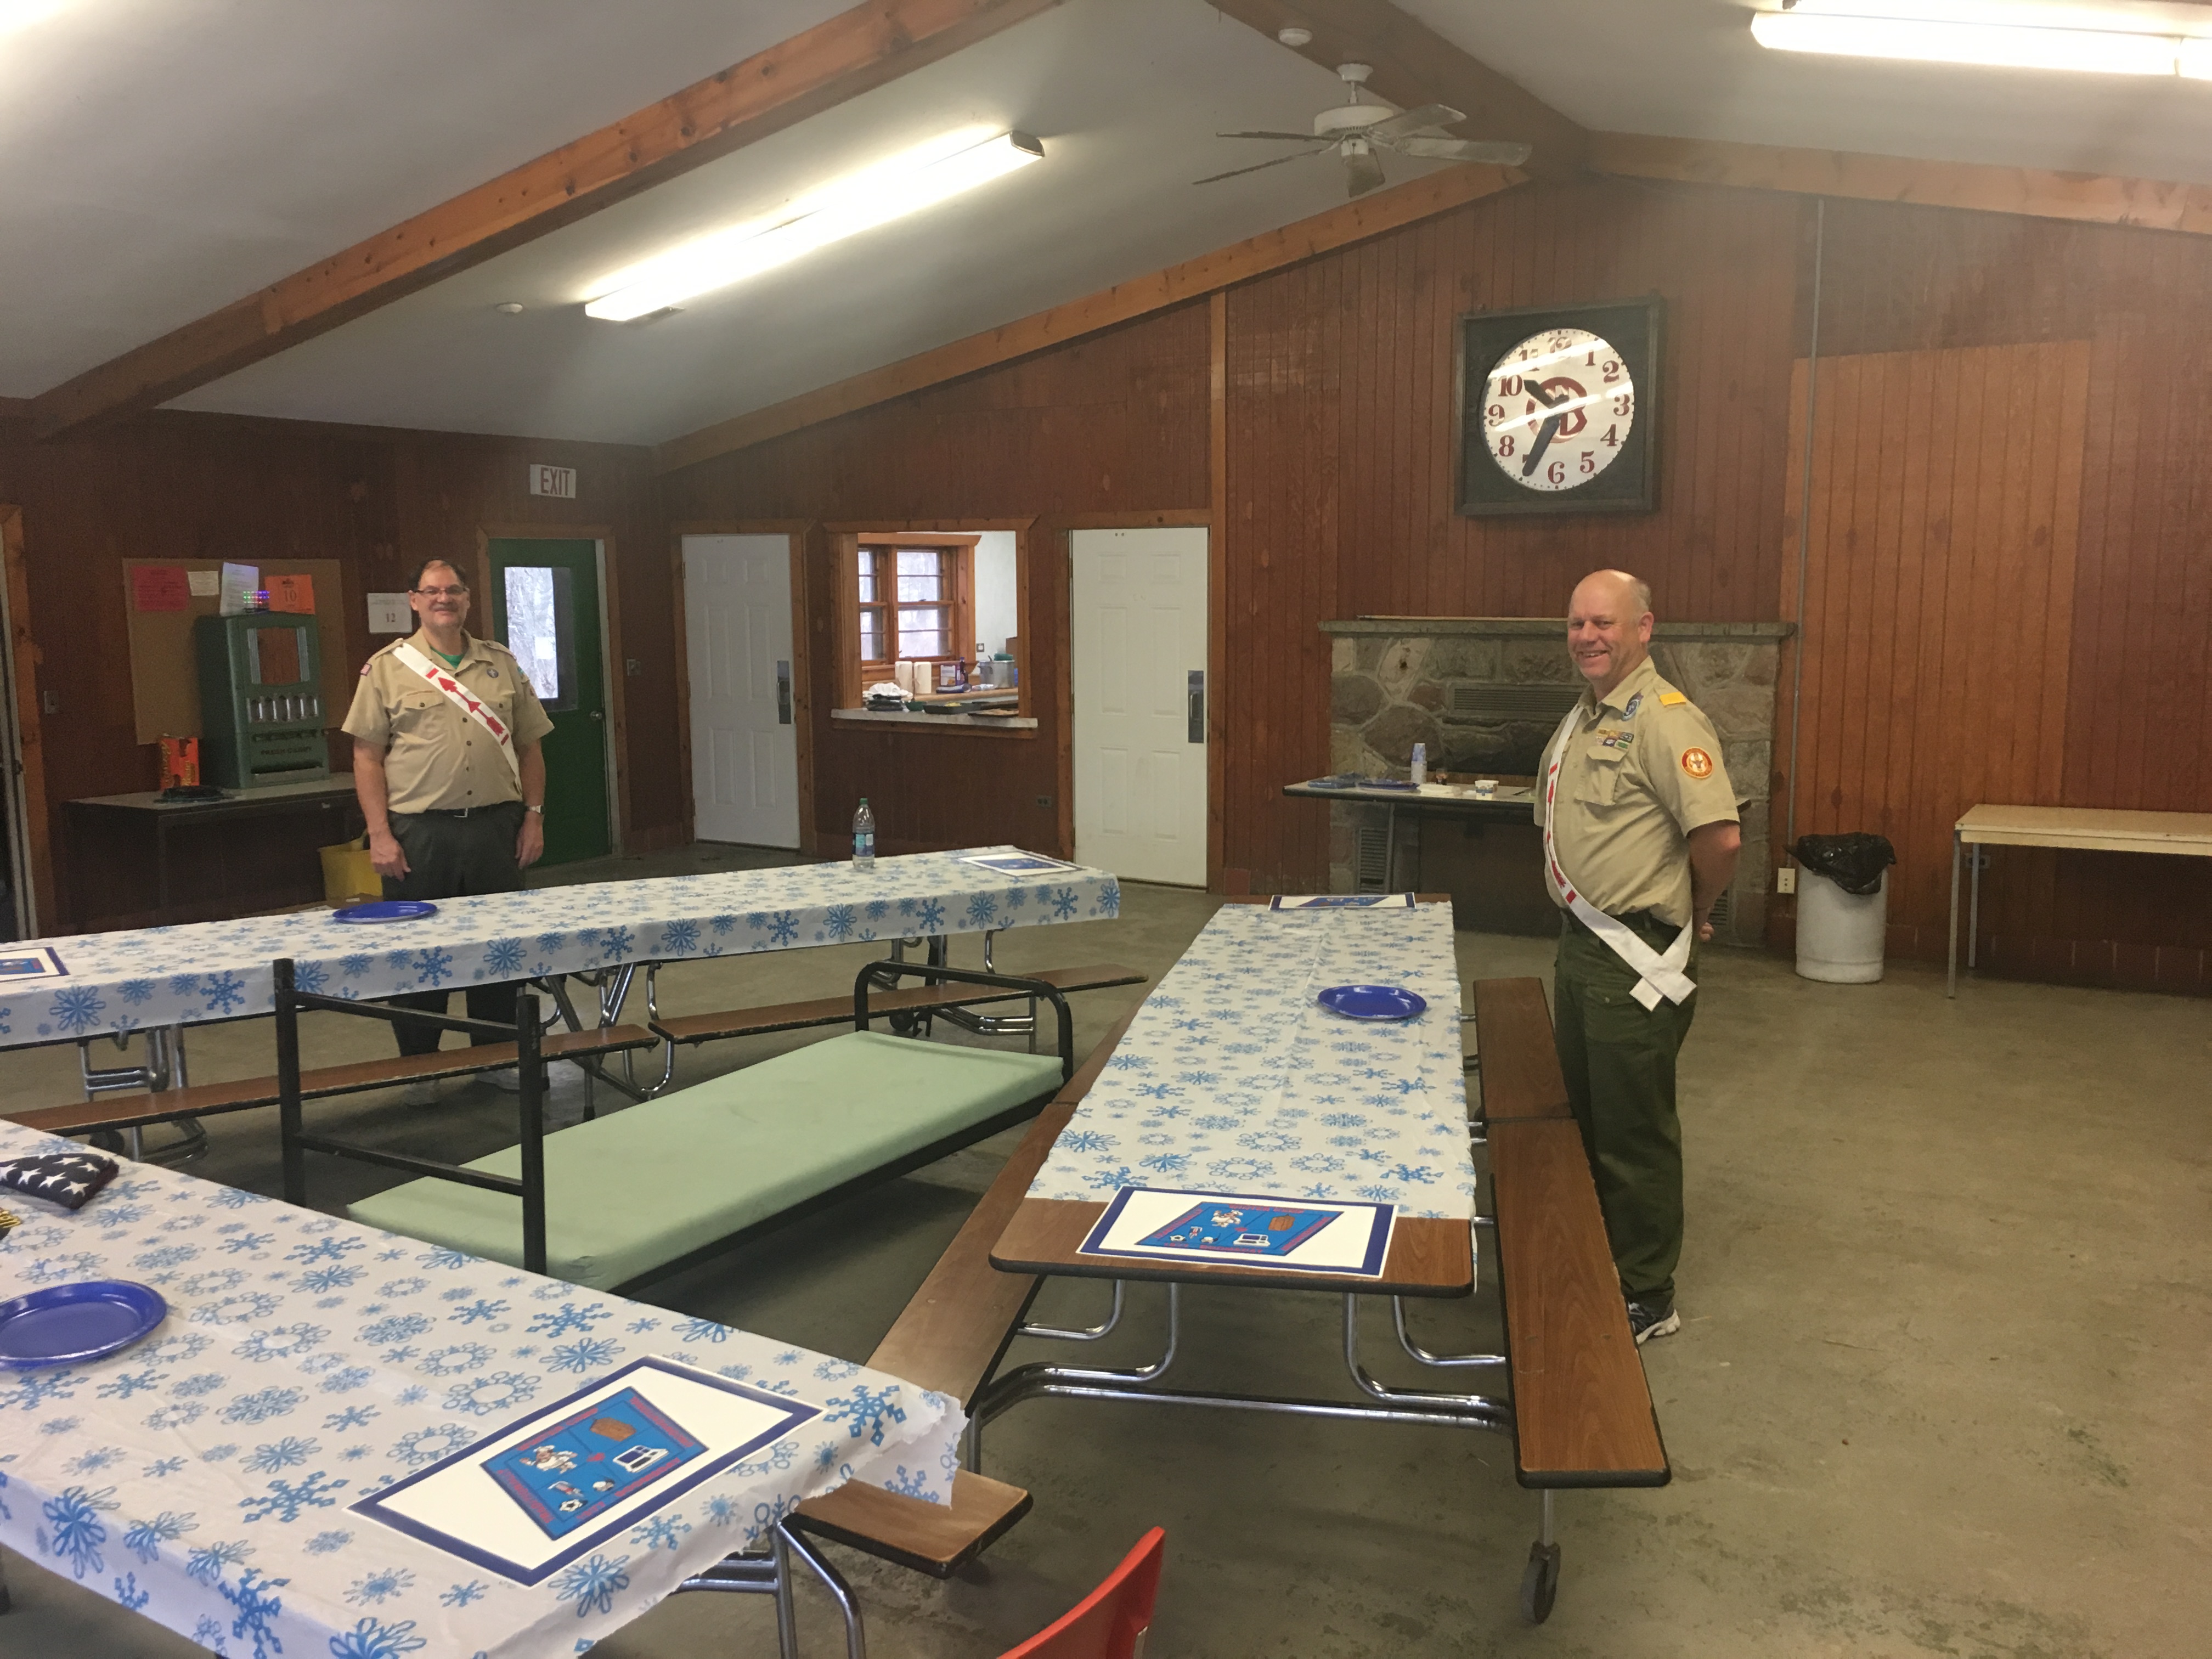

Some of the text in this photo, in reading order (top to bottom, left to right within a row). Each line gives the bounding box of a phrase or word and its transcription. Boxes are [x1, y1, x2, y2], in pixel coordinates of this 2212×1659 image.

[1602, 360, 1620, 383] 2
[1498, 375, 1522, 397] 10
[1488, 404, 1505, 427] 9
[1613, 393, 1630, 416] 3
[1498, 435, 1515, 457] 8
[1600, 424, 1618, 447] 4
[1547, 461, 1565, 484] 6
[1579, 450, 1595, 474] 5
[540, 467, 570, 496] EXIT
[284, 589, 297, 602] 10
[386, 612, 396, 623] 12
